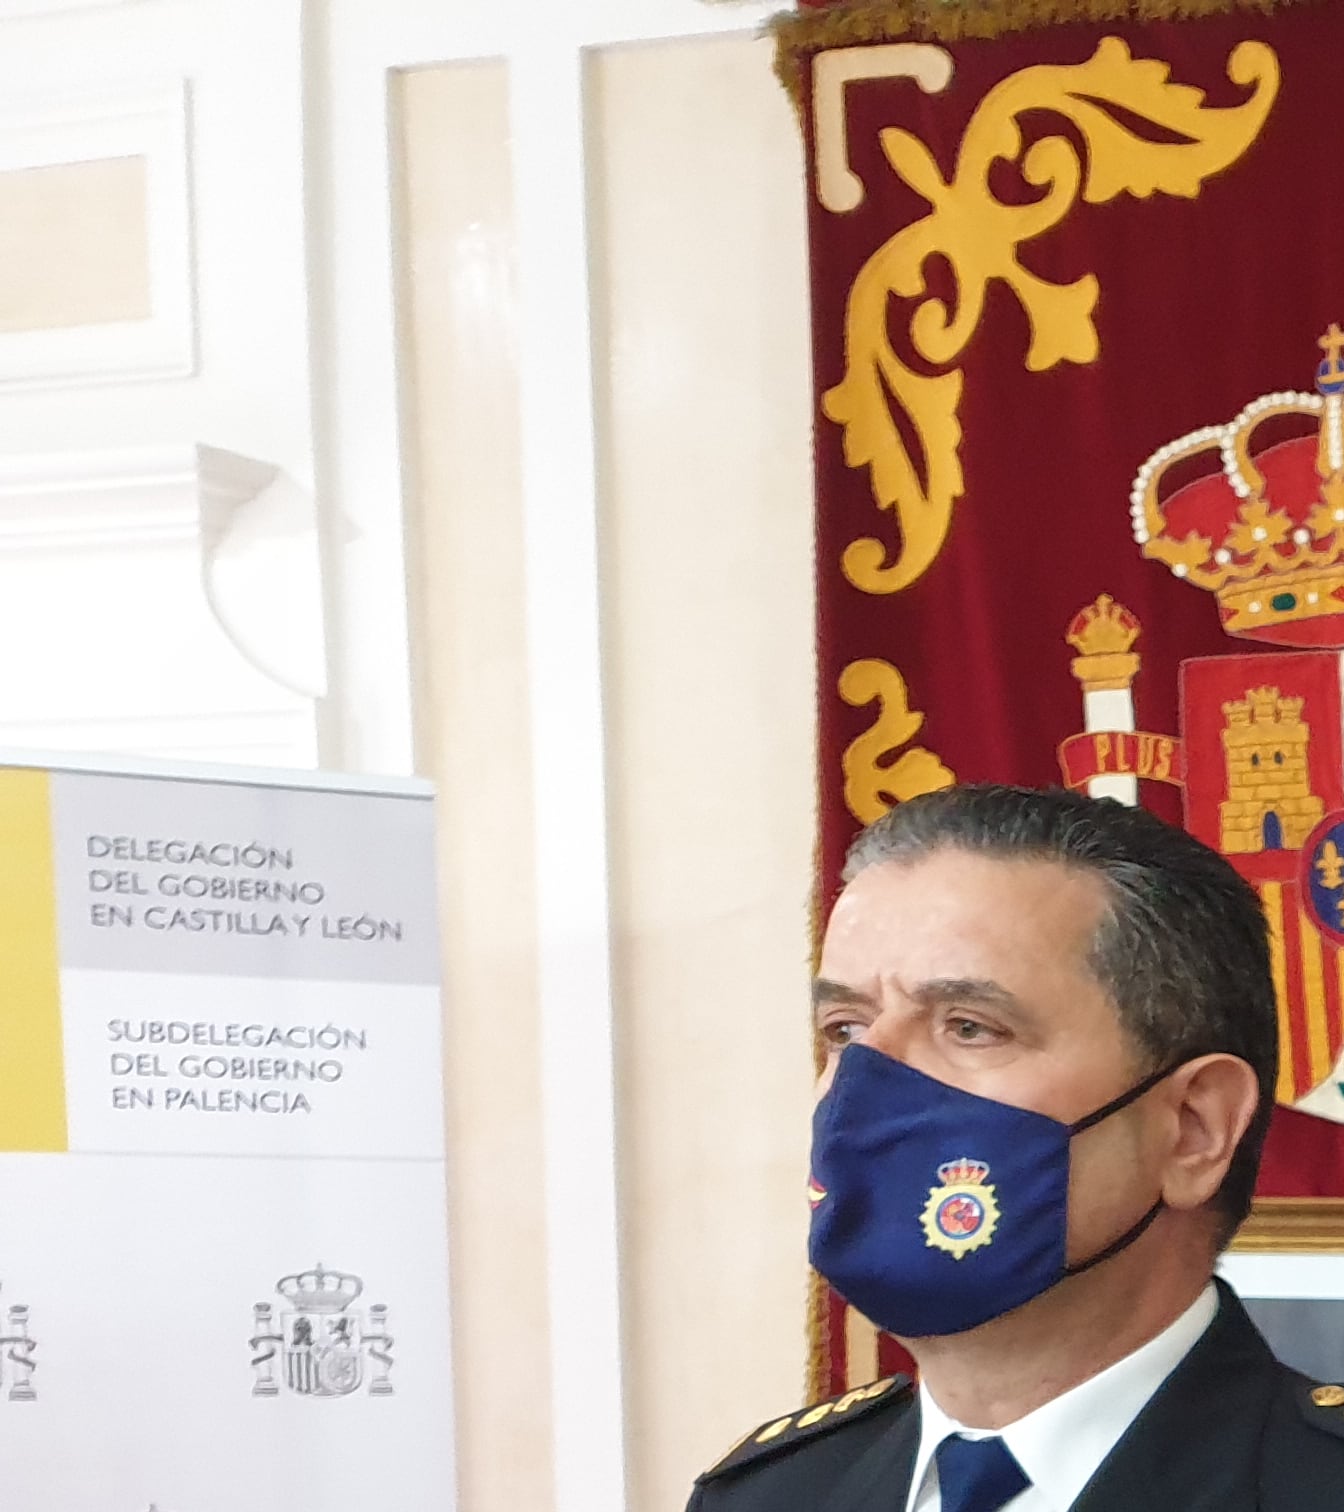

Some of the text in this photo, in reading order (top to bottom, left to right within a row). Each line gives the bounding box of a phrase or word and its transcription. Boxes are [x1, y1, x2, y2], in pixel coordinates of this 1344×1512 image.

[1094, 734, 1174, 779] PLUS
[87, 835, 293, 870] DELEGACIÓN
[89, 870, 325, 905] DEL GOBIERNO
[90, 904, 402, 942] EN CASTILLA Y LEÓN
[107, 1018, 367, 1051] SUBDELEGACIÓN
[111, 1052, 343, 1083] DEL GOBIERNO
[111, 1087, 312, 1113] EN PALENCIA
